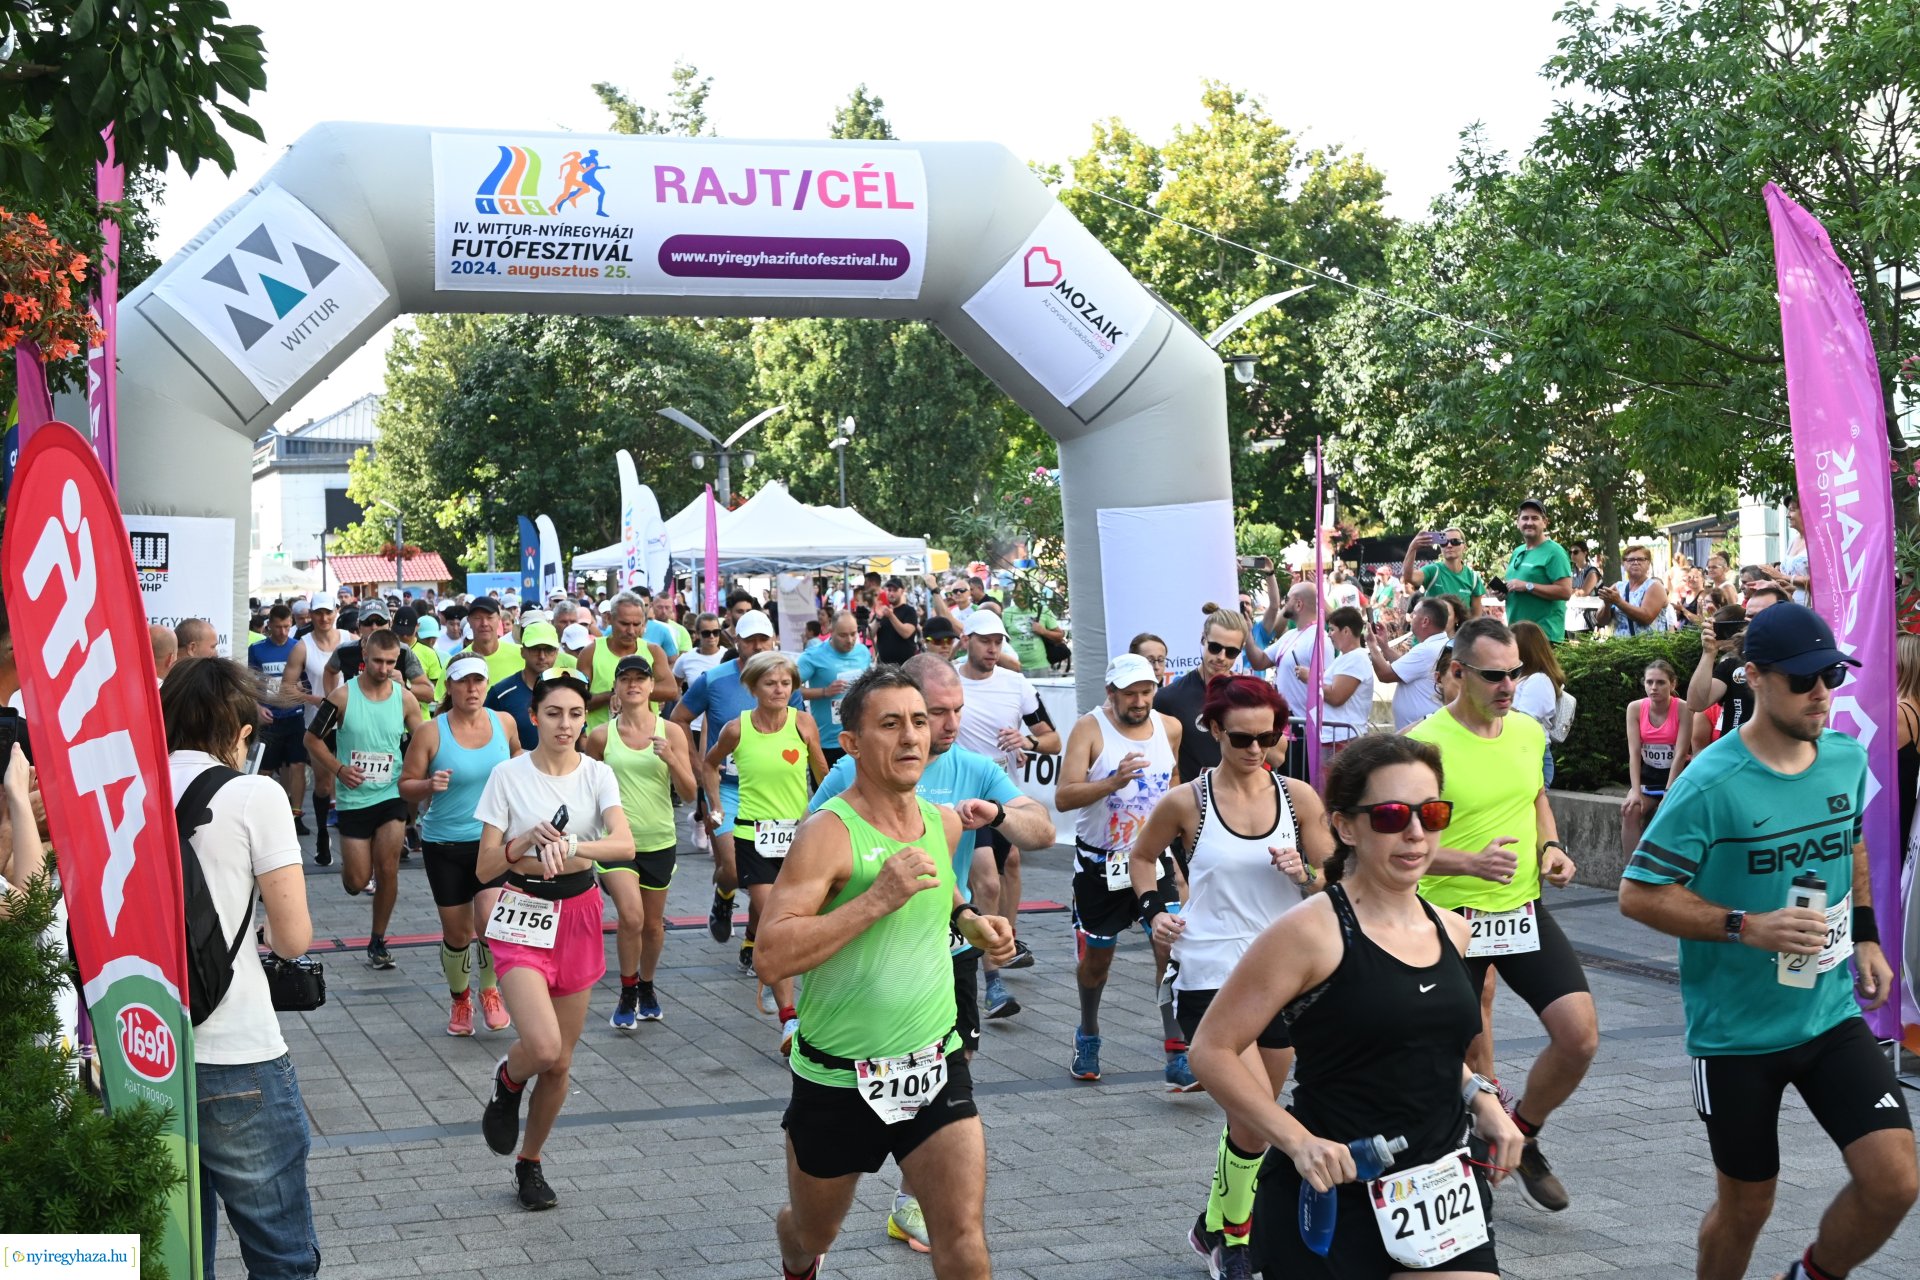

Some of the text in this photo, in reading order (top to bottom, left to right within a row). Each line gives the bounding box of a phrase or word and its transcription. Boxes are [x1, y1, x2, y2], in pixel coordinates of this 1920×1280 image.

[654, 162, 915, 211] RAJT/CÉL
[454, 222, 633, 239] IV. WITTUR-NYÍREGYHÁZI
[451, 235, 634, 262] FUTÓFESZTIVÁL
[671, 250, 898, 267] www.nyiregyhazifutofesztival.hu
[451, 260, 631, 279] 2024. augusztus 25.
[1055, 279, 1123, 345] MOZAIK
[280, 298, 340, 352] WITTUR
[137, 572, 169, 582] COPE
[1644, 750, 1674, 760] 10018
[760, 832, 796, 845] 2104
[493, 906, 554, 931] 21156
[1471, 917, 1531, 938] 21016
[1391, 1183, 1475, 1241] 21022
